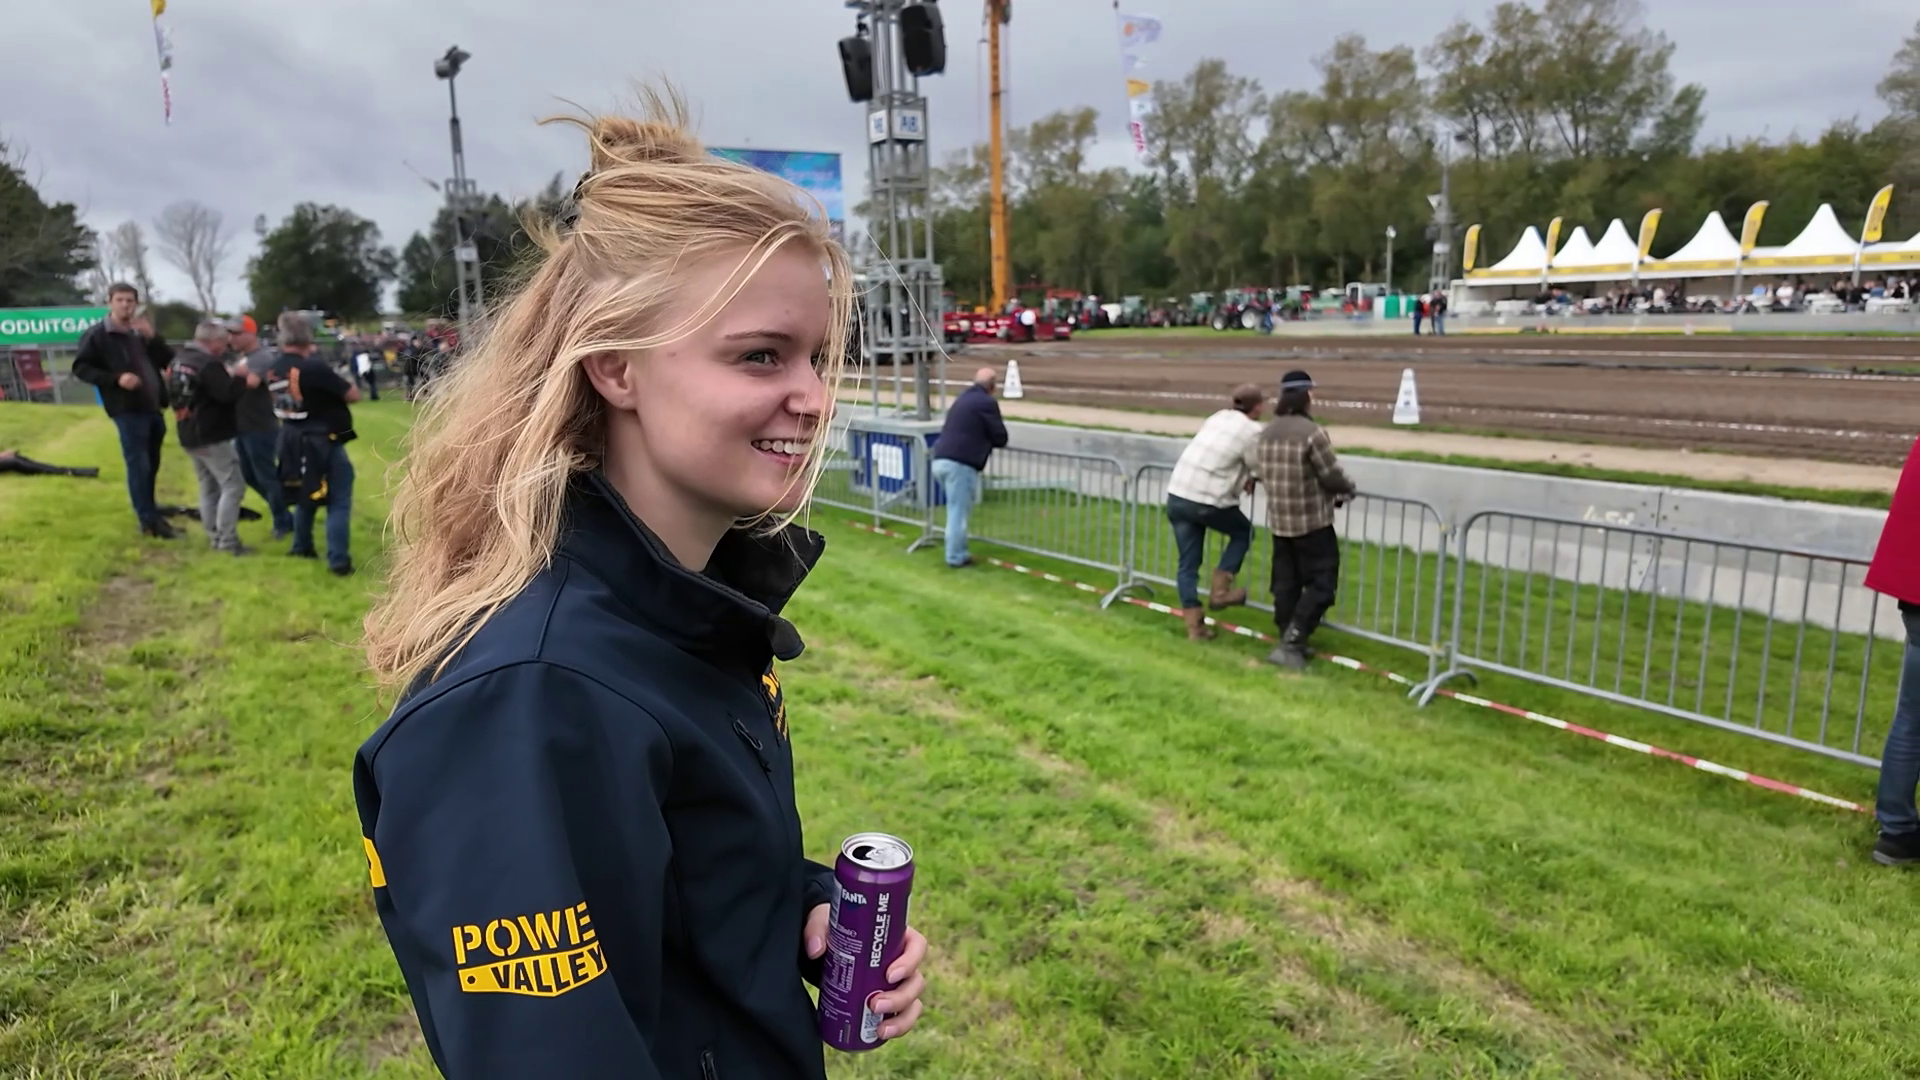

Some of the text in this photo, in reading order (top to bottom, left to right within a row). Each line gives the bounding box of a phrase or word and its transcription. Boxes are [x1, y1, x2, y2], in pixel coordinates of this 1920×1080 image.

[841, 888, 867, 904] FANTA
[877, 892, 890, 912] ME
[869, 914, 887, 967] RECYCLE
[491, 945, 605, 992] VALLEY
